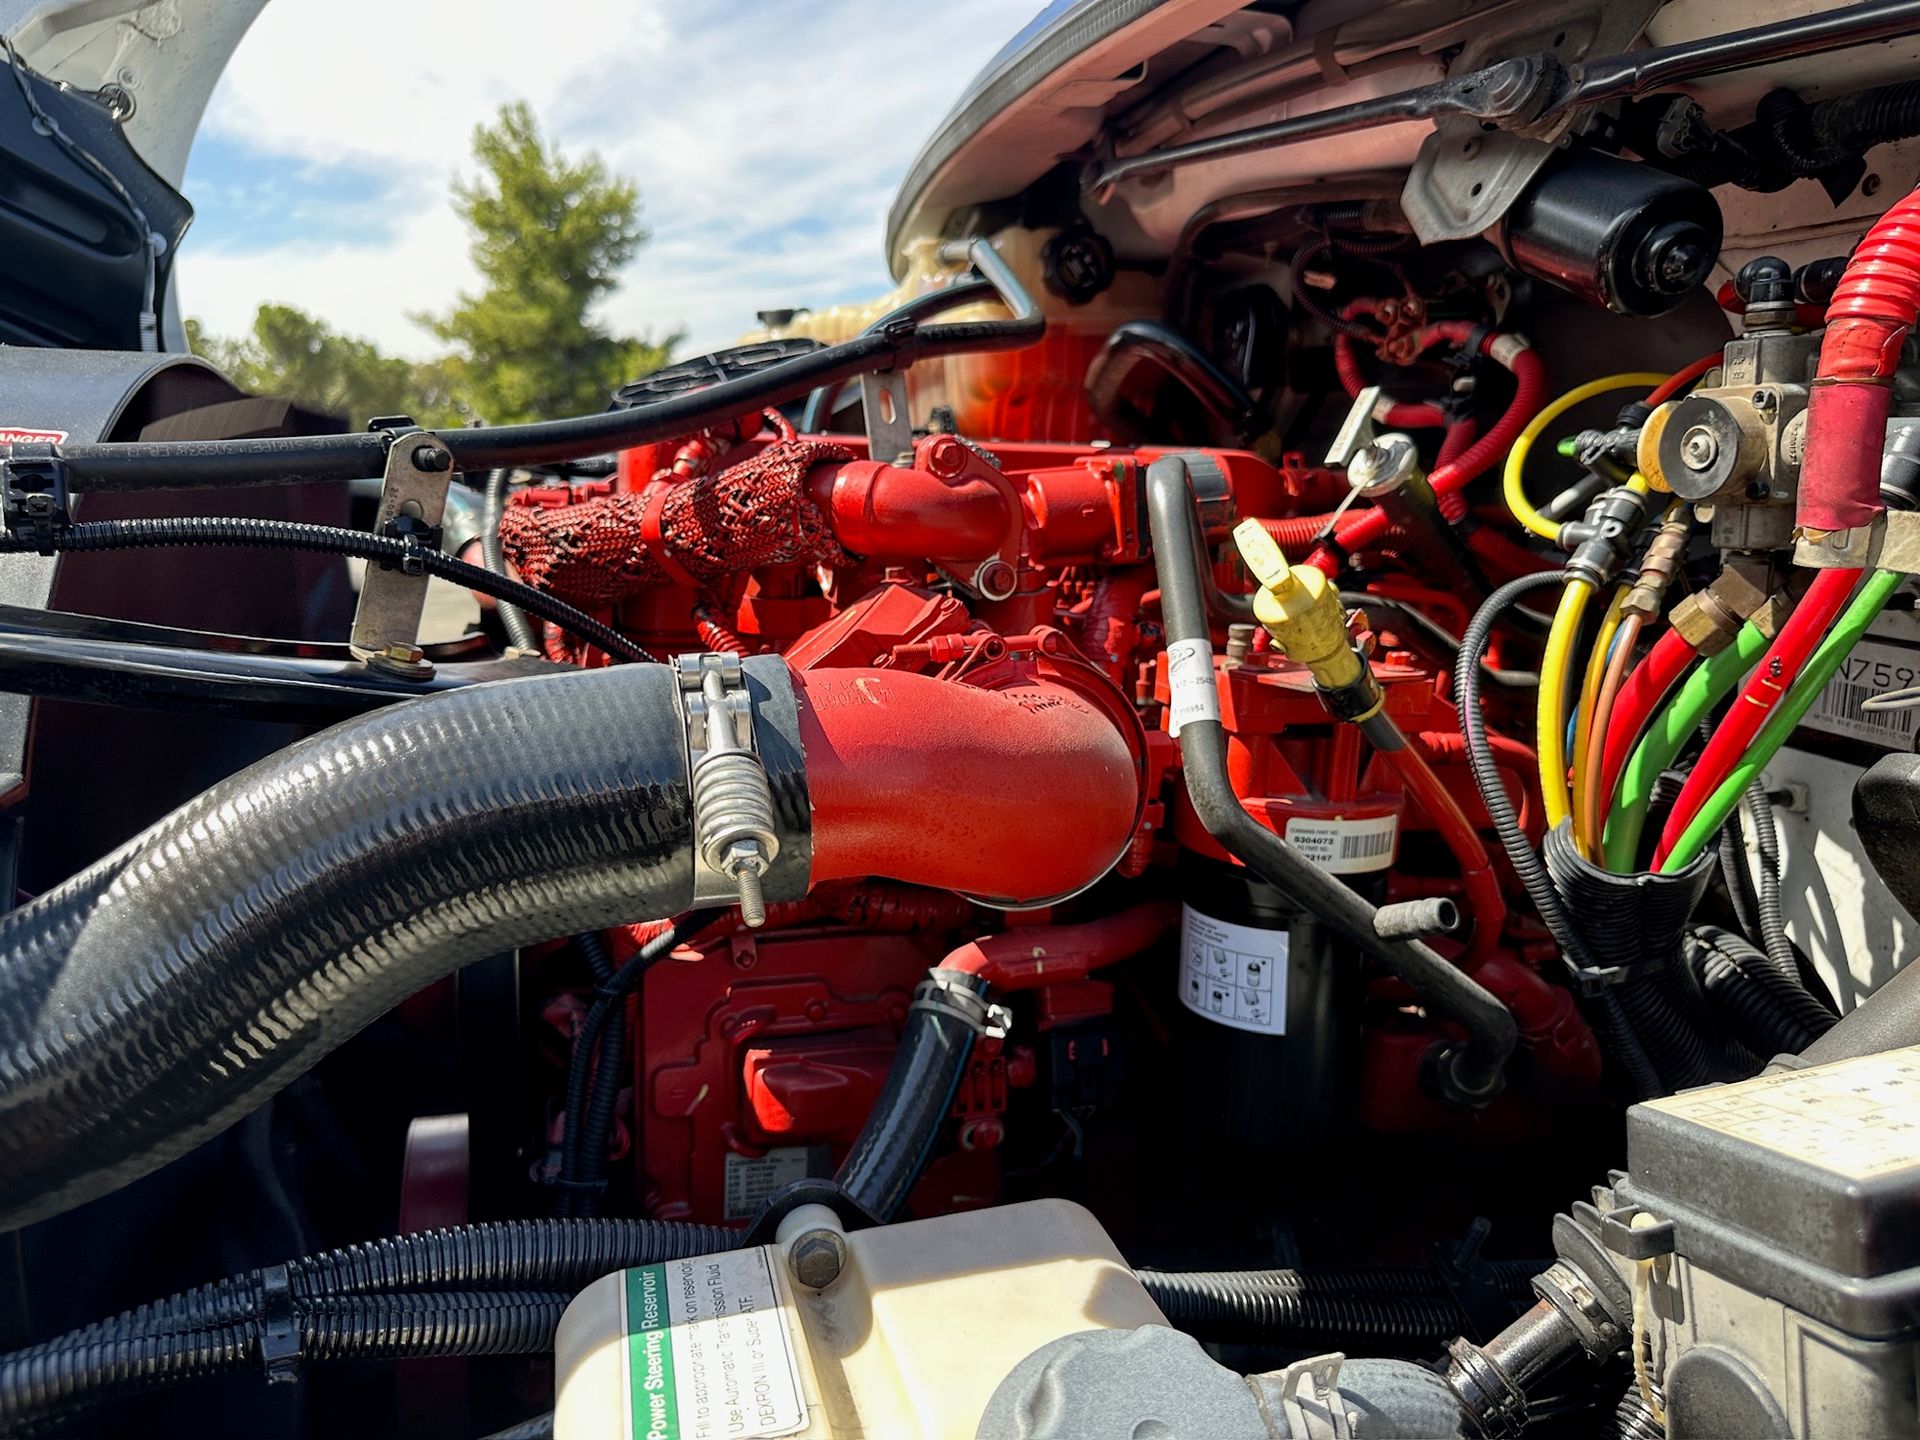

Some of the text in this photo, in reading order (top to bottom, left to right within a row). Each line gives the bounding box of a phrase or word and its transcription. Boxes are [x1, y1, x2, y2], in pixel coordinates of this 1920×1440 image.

[0, 433, 57, 443] ANGER
[686, 1300, 697, 1313] on
[739, 1294, 754, 1314] ATF.
[705, 1263, 745, 1433] Use Automatic Transmission Fluid
[745, 1316, 763, 1348] Super
[638, 1271, 669, 1440] Power Steering Reservoir
[690, 1341, 711, 1404] appropriate
[697, 1406, 710, 1418] to
[753, 1375, 777, 1427] DEXRON
